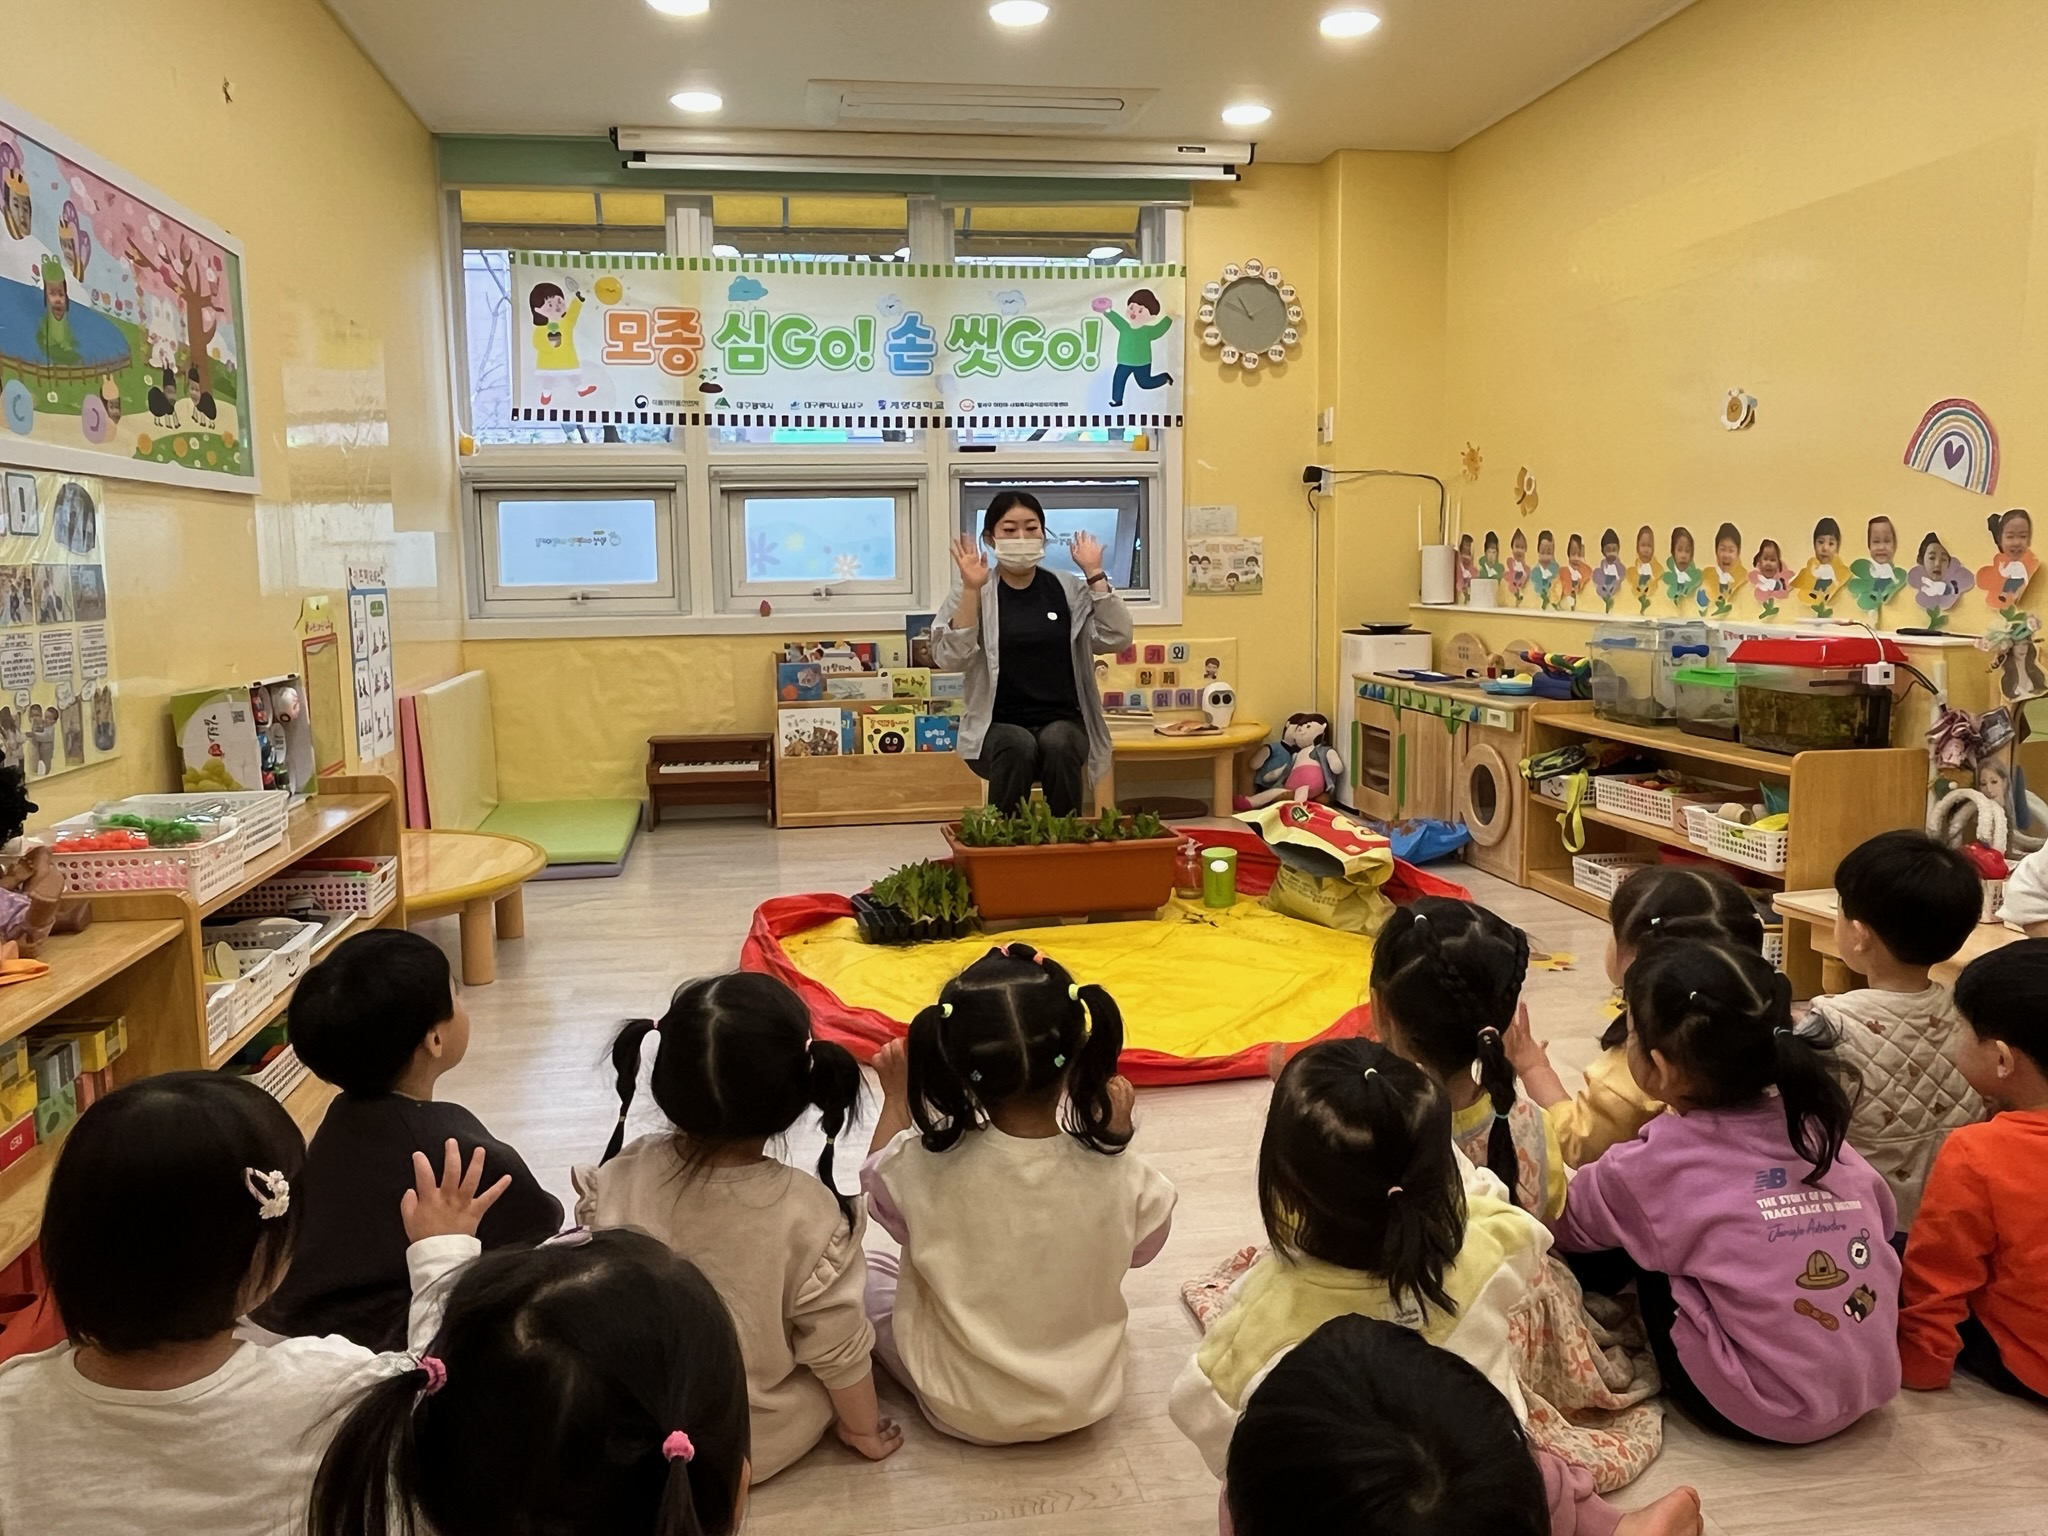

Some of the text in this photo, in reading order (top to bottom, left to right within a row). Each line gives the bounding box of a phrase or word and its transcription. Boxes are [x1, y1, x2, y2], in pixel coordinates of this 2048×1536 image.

[602, 307, 1103, 378] 모종 심Go! 손 씻Go!
[736, 401, 774, 410] 대구광역시
[804, 401, 839, 410] 대구광역시
[890, 400, 945, 410] 계명대학교
[1756, 1196, 1778, 1209] THE
[1778, 1192, 1808, 1205] STORY
[1761, 1206, 1799, 1221] TRACES
[1799, 1203, 1822, 1215] BACK
[1822, 1202, 1834, 1213] TO
